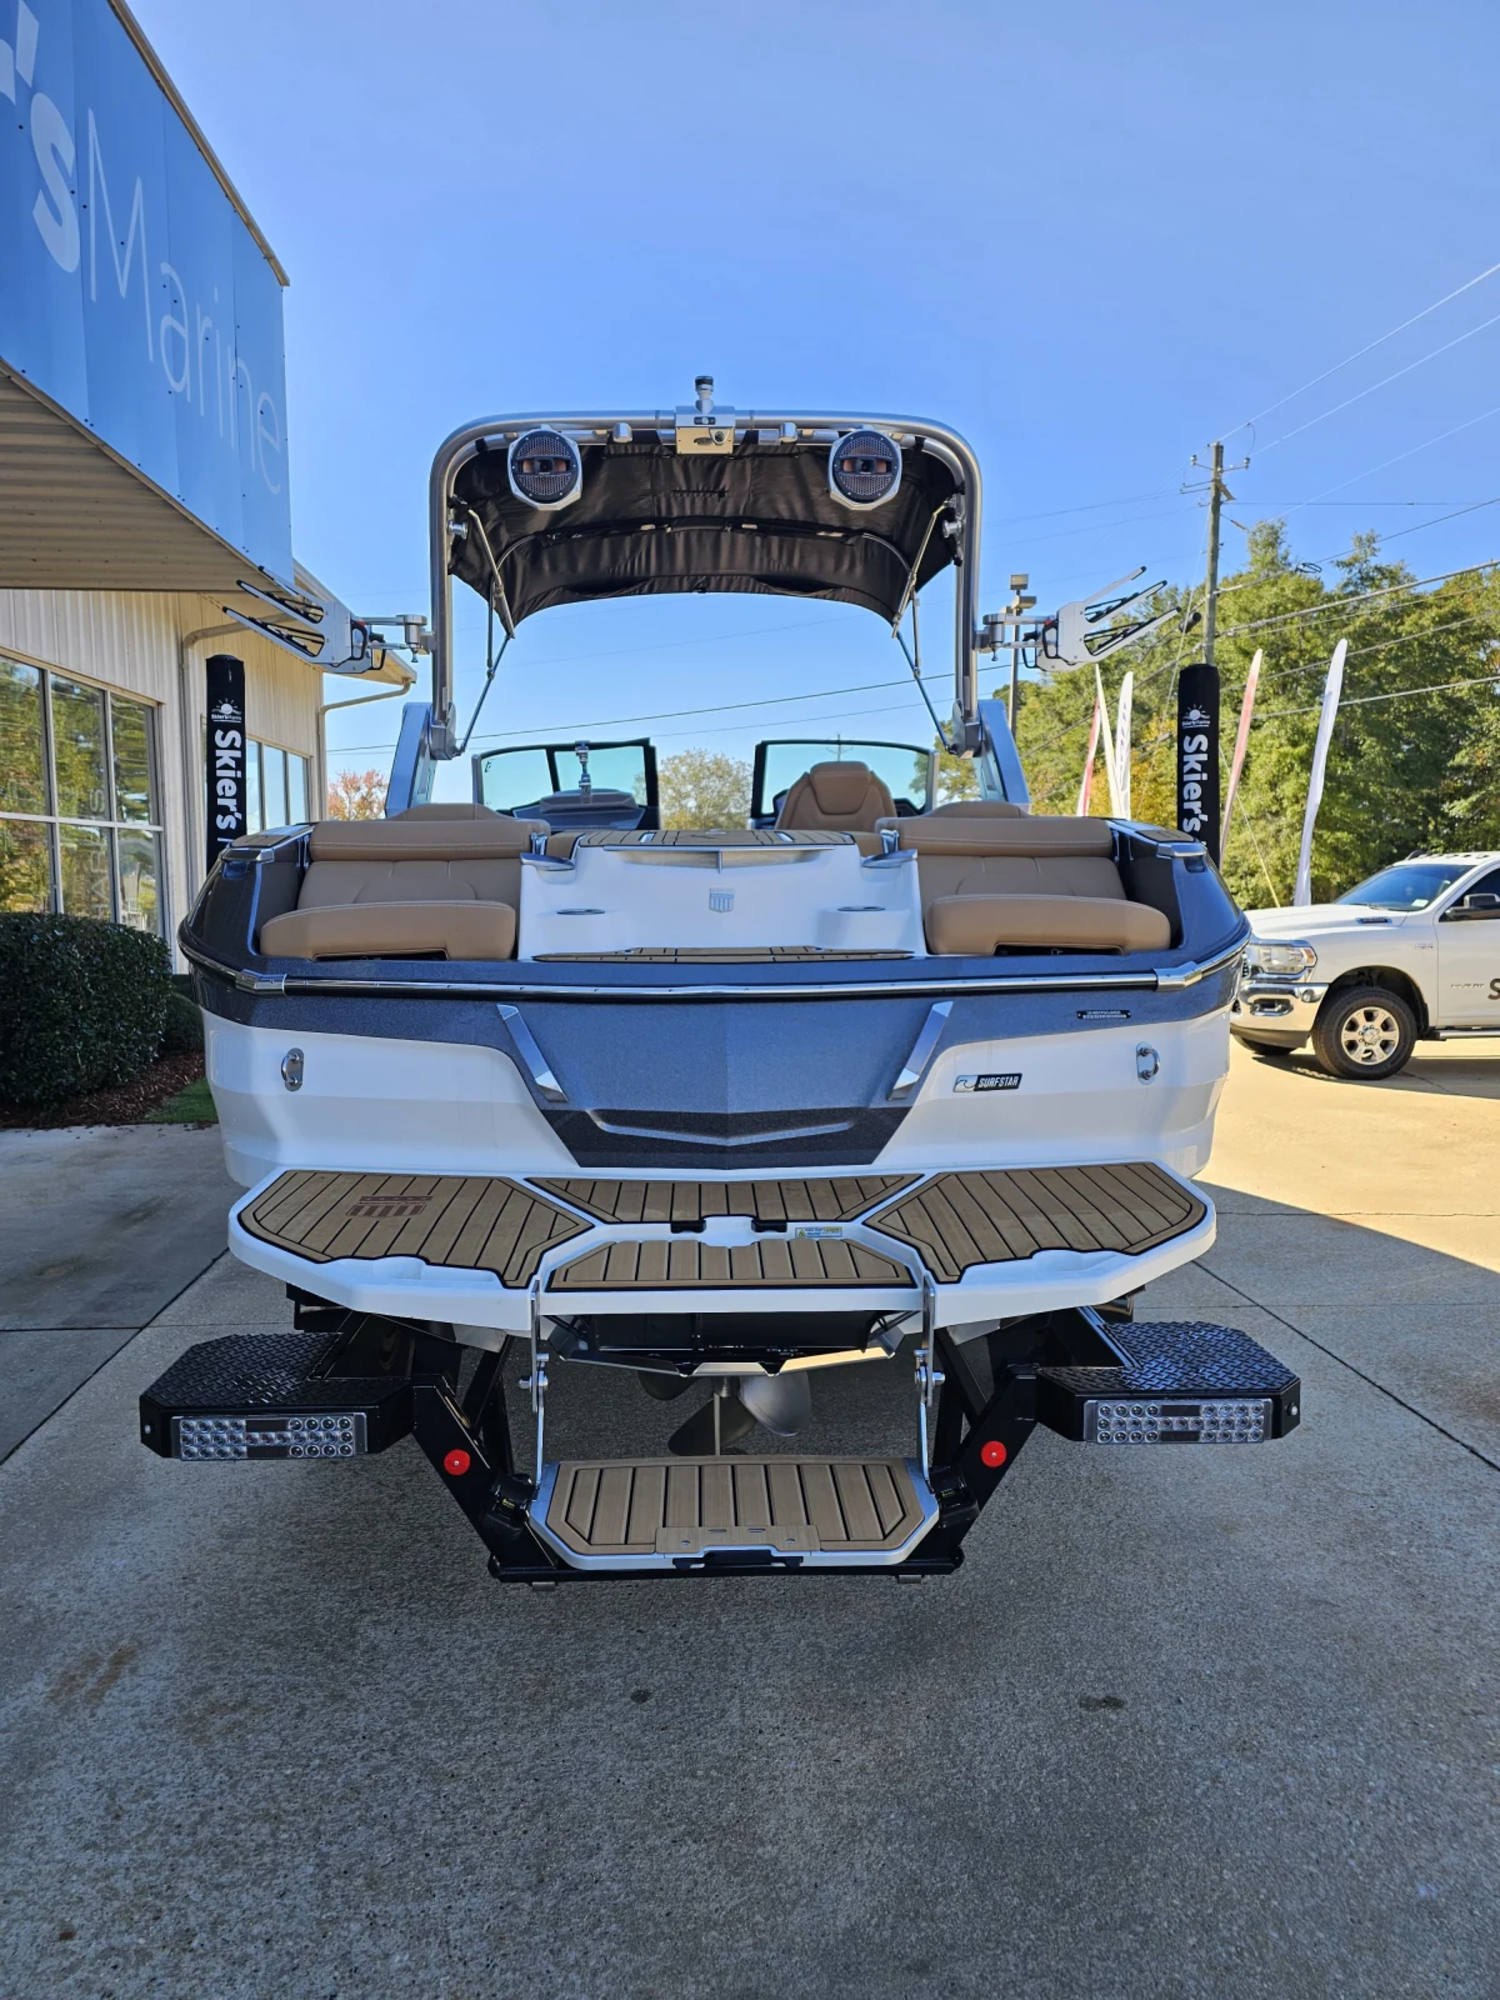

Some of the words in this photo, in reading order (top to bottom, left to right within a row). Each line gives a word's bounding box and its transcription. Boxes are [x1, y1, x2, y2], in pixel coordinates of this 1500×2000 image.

[215, 729, 242, 830] Skier's
[1183, 734, 1209, 833] Skier's
[978, 1075, 1020, 1089] SURFSTAR
